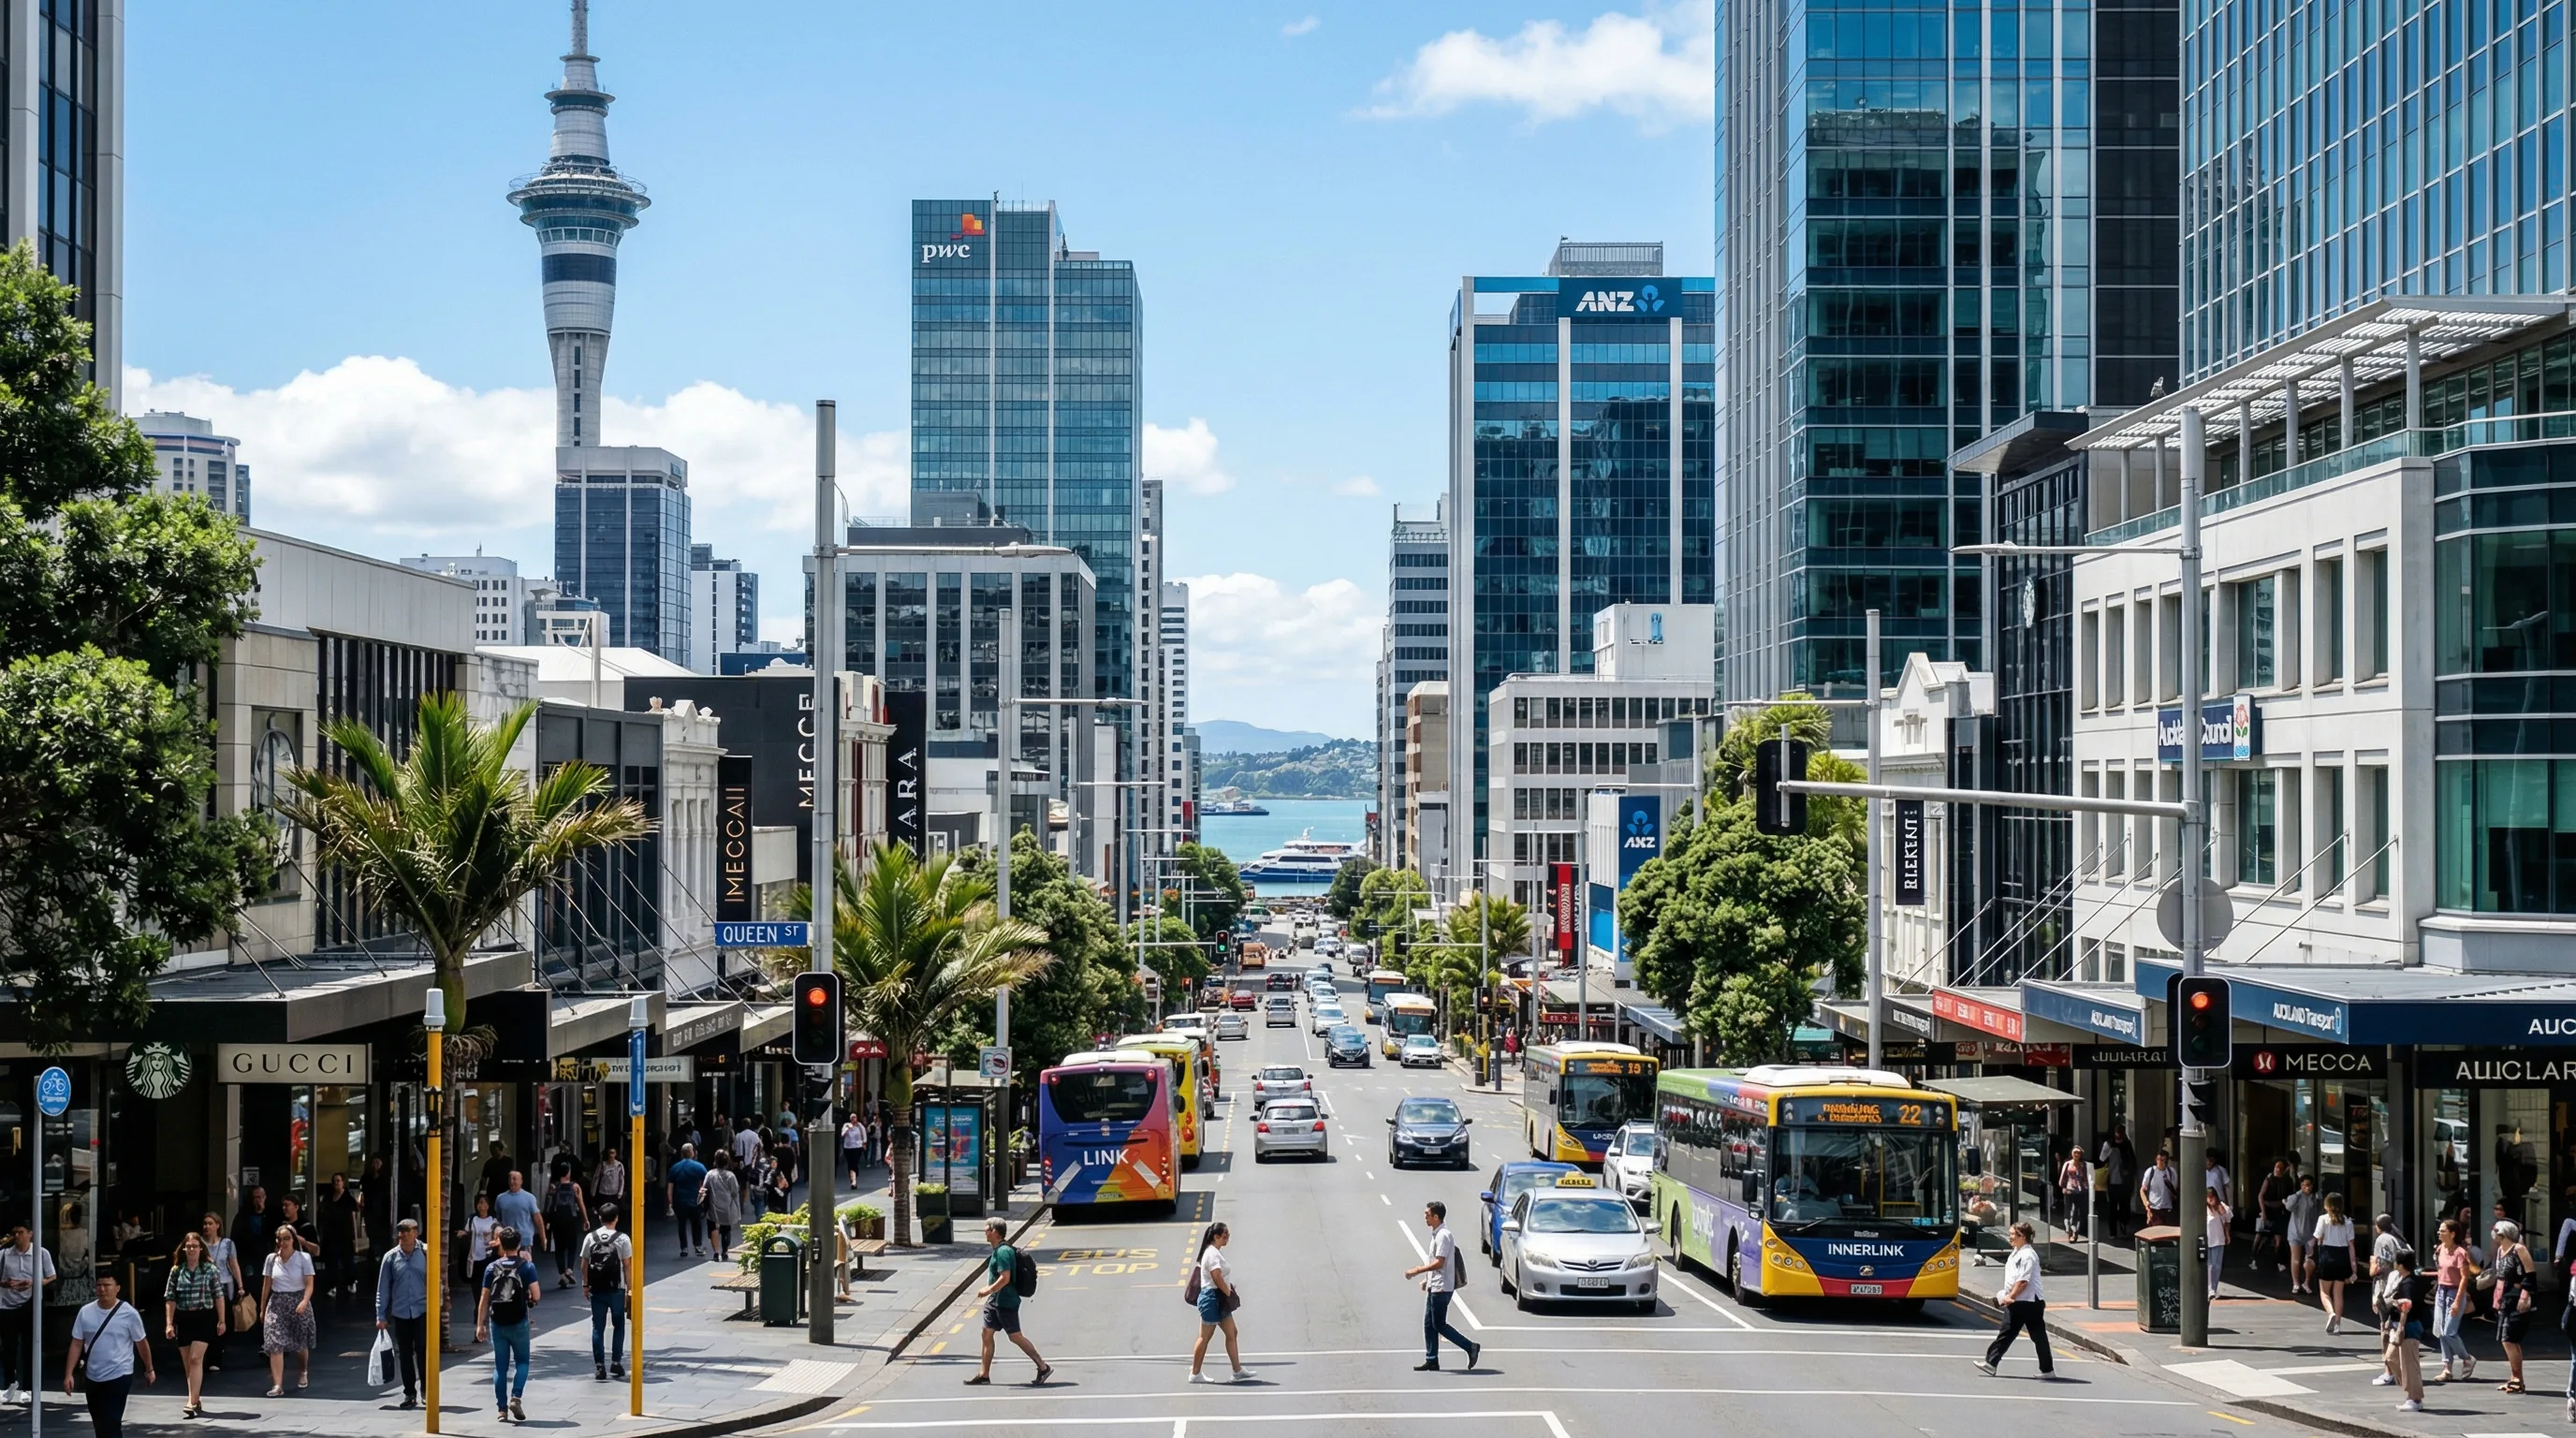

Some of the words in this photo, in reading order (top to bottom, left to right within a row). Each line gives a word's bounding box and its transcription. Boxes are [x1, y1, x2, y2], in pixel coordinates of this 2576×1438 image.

[921, 243, 971, 263] pwc
[1574, 290, 1634, 312] ANZ
[723, 925, 778, 944] QUEEN
[784, 924, 799, 937] ST
[232, 1052, 353, 1074] GUCCI
[2285, 1053, 2373, 1072] MECCA
[1898, 1104, 1922, 1125] 22
[1083, 1148, 1130, 1167] LINK
[1057, 1248, 1159, 1261] BUS
[1827, 1242, 1905, 1257] INNERLINK
[1037, 1262, 1159, 1276] STOP
